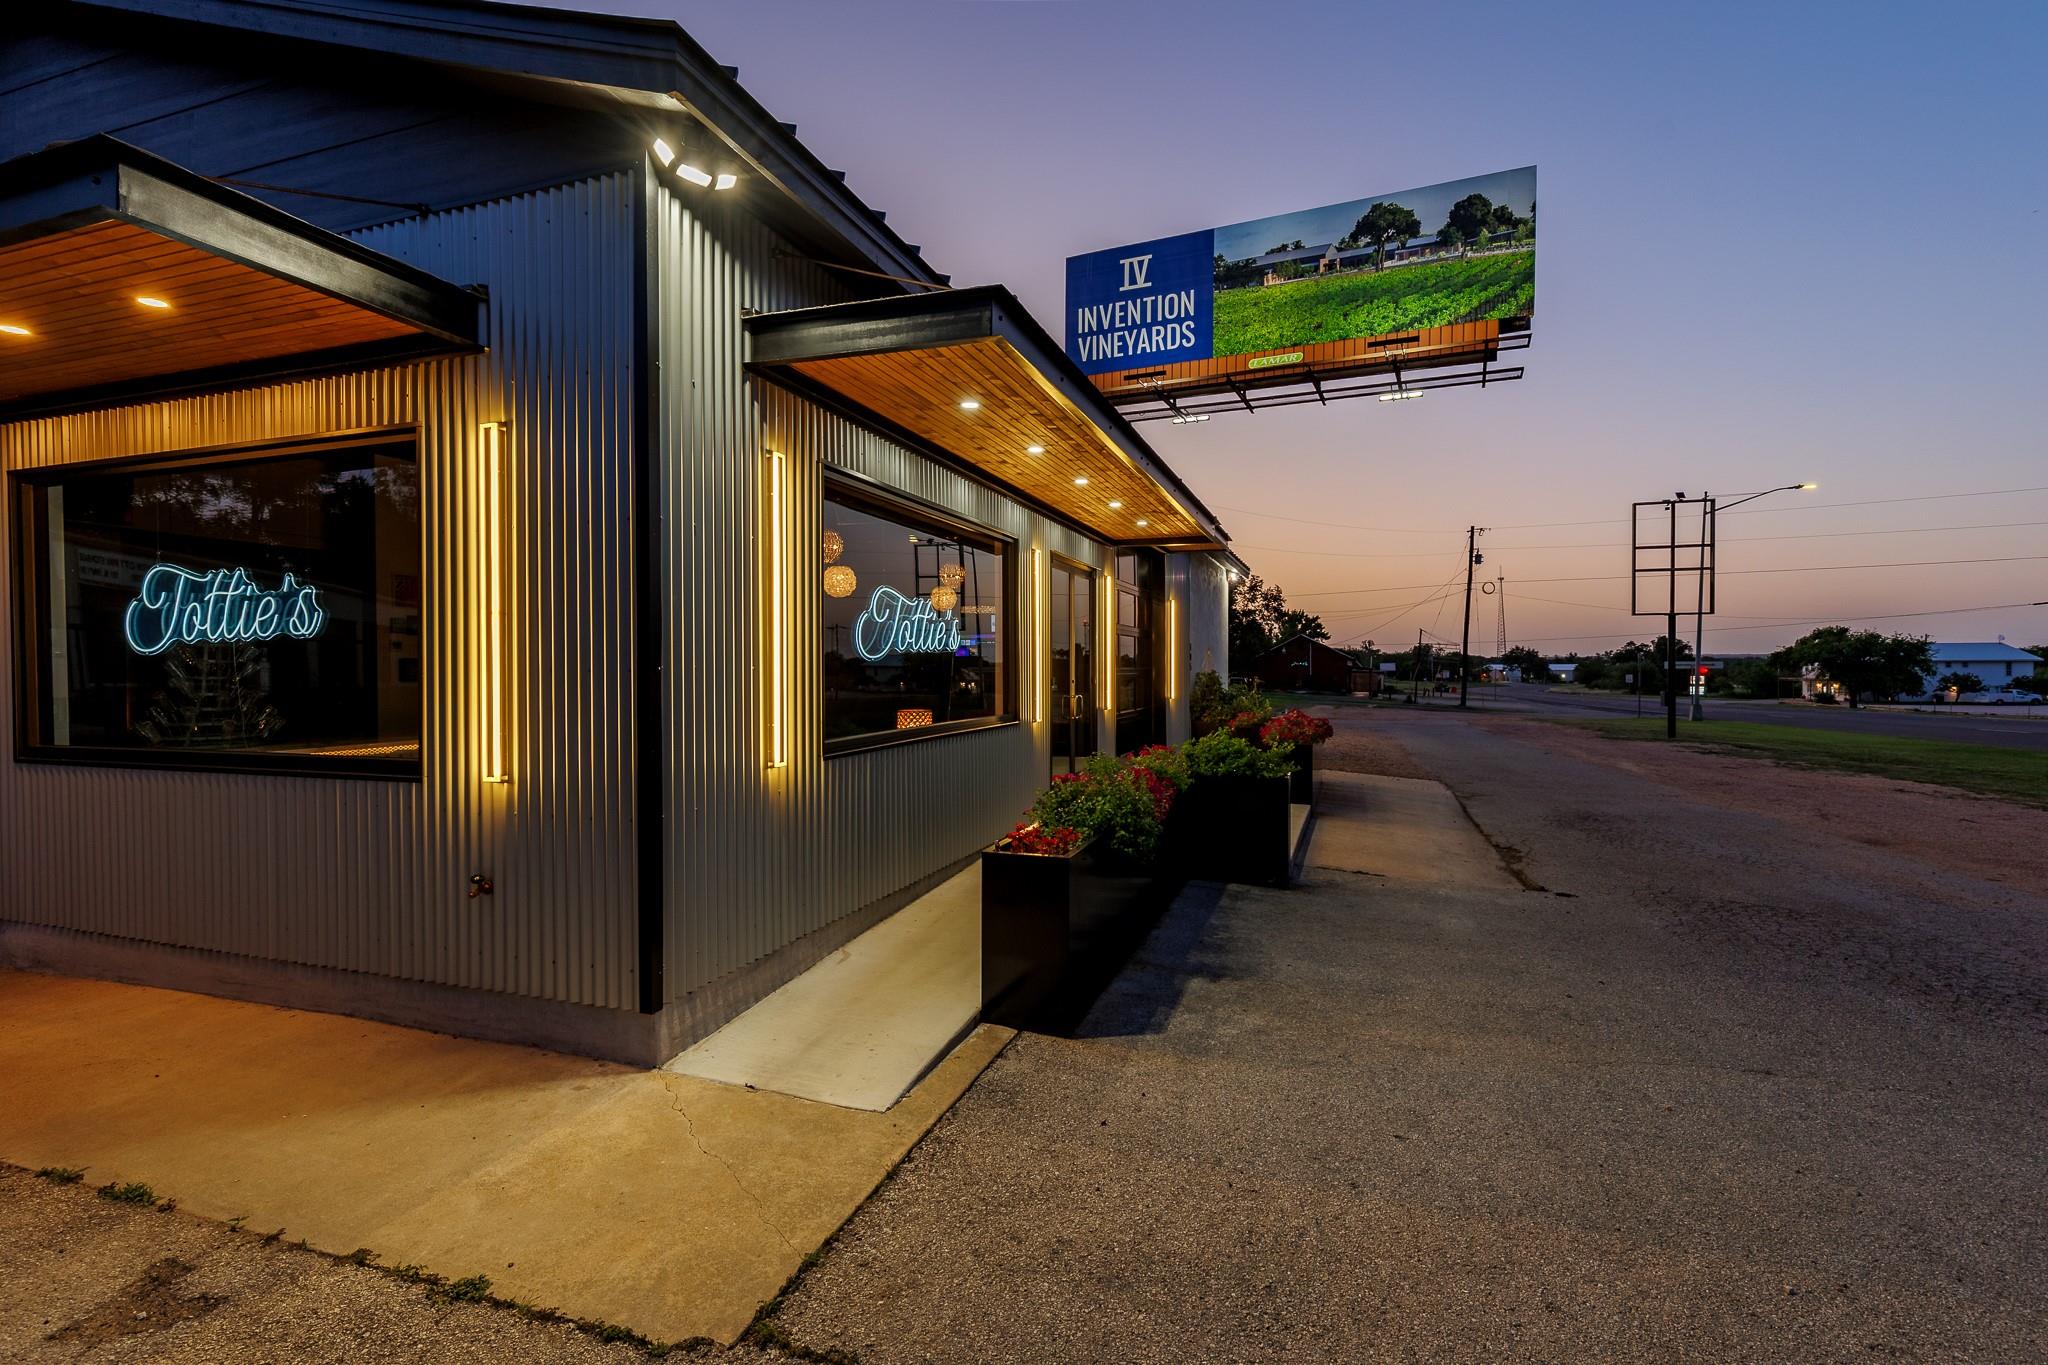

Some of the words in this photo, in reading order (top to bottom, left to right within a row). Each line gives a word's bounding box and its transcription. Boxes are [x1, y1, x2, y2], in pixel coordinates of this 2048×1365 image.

[1119, 254, 1152, 291] IV
[1078, 289, 1195, 333] INVENTION
[1078, 321, 1196, 362] VINEYARDS
[1253, 354, 1298, 367] LAMAR
[125, 564, 321, 654] Tottie's
